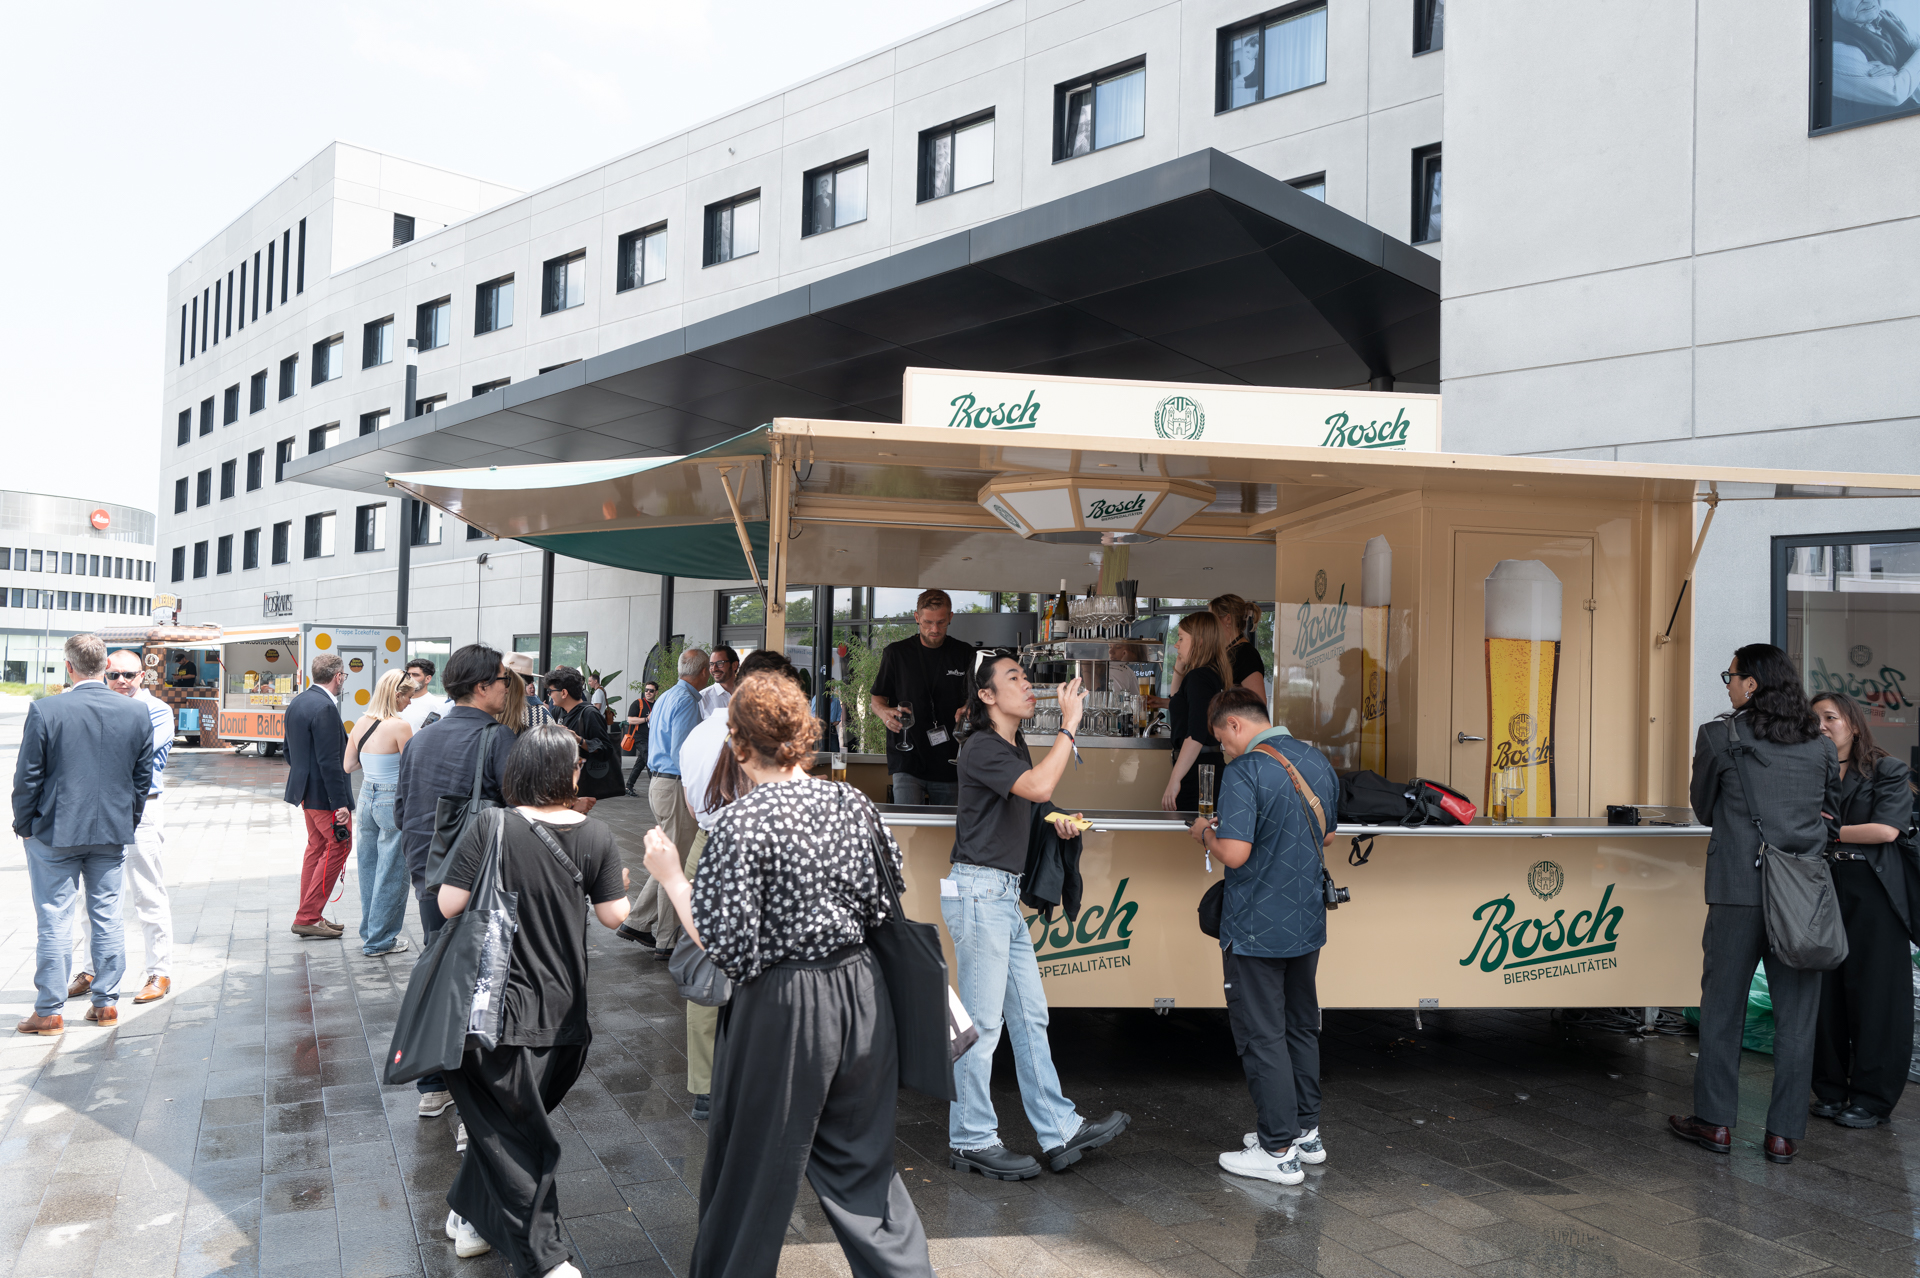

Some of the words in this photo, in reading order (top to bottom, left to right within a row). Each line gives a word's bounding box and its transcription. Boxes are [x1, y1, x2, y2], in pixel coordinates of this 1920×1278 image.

[948, 389, 1041, 429] Bosch
[1318, 407, 1411, 448] Bosch
[1086, 493, 1146, 519] Bosch
[335, 628, 353, 636] Frappe
[355, 628, 381, 636] Icekaffee
[1293, 583, 1348, 660] Bosch
[1306, 645, 1346, 669] BIERSPEZIALITÄTEN
[1363, 691, 1387, 721] Bosch
[220, 713, 247, 734] Donut
[257, 714, 286, 736] Bällch
[1493, 736, 1550, 770] Bosch
[1024, 877, 1138, 953] osch
[1459, 883, 1624, 973] Bosch
[1039, 955, 1131, 978] SPEZIALITÄTEN
[1503, 957, 1617, 985] BIERSPEZIALITÄTEN
